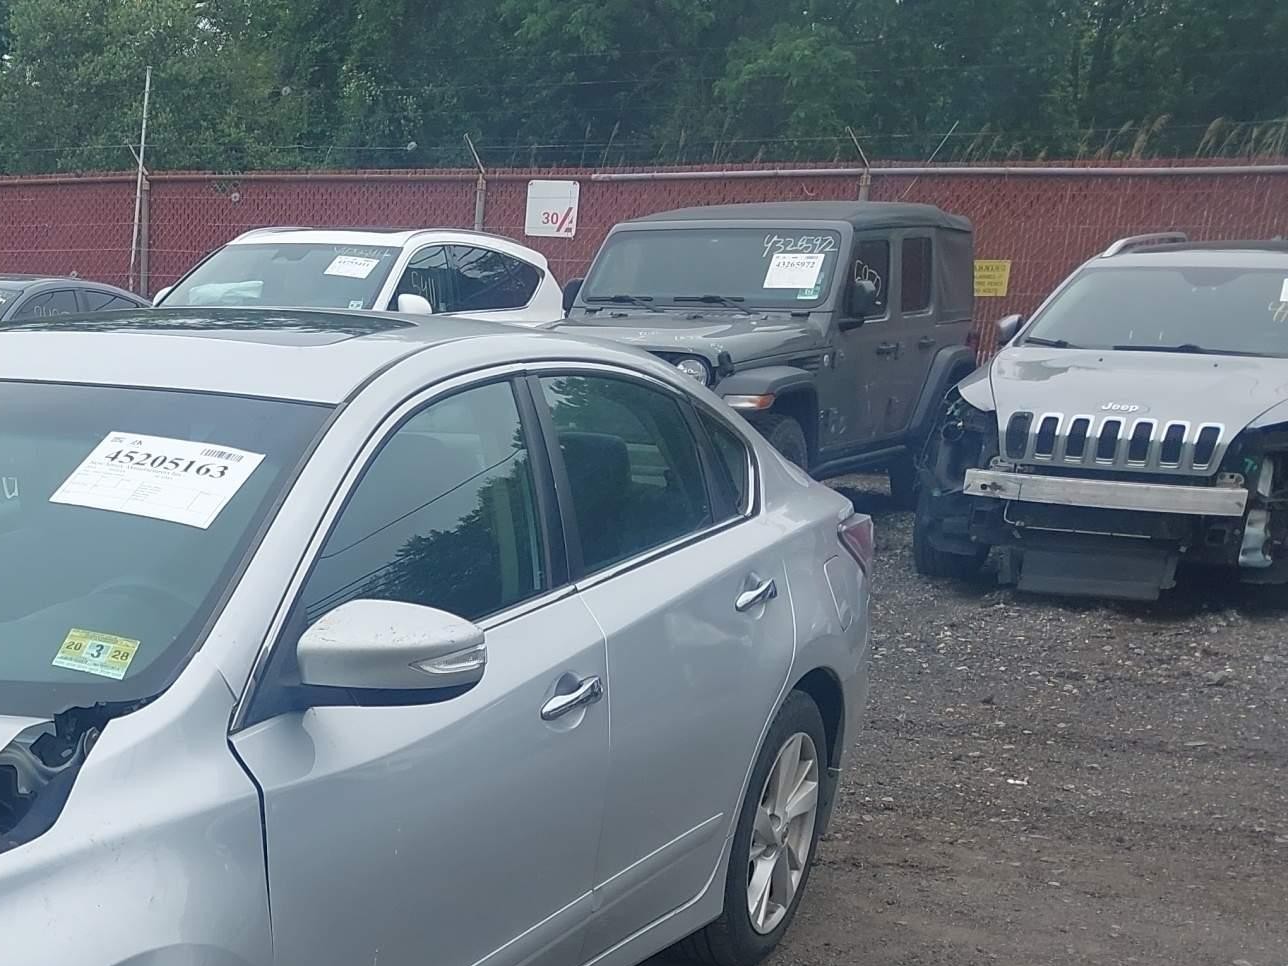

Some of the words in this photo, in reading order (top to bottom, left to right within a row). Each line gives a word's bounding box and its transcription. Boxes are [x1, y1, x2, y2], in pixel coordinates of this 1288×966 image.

[1101, 402, 1139, 413] Jeep
[104, 449, 229, 479] 45205163
[65, 640, 83, 652] 20
[90, 643, 105, 659] 3
[111, 649, 130, 661] 28
